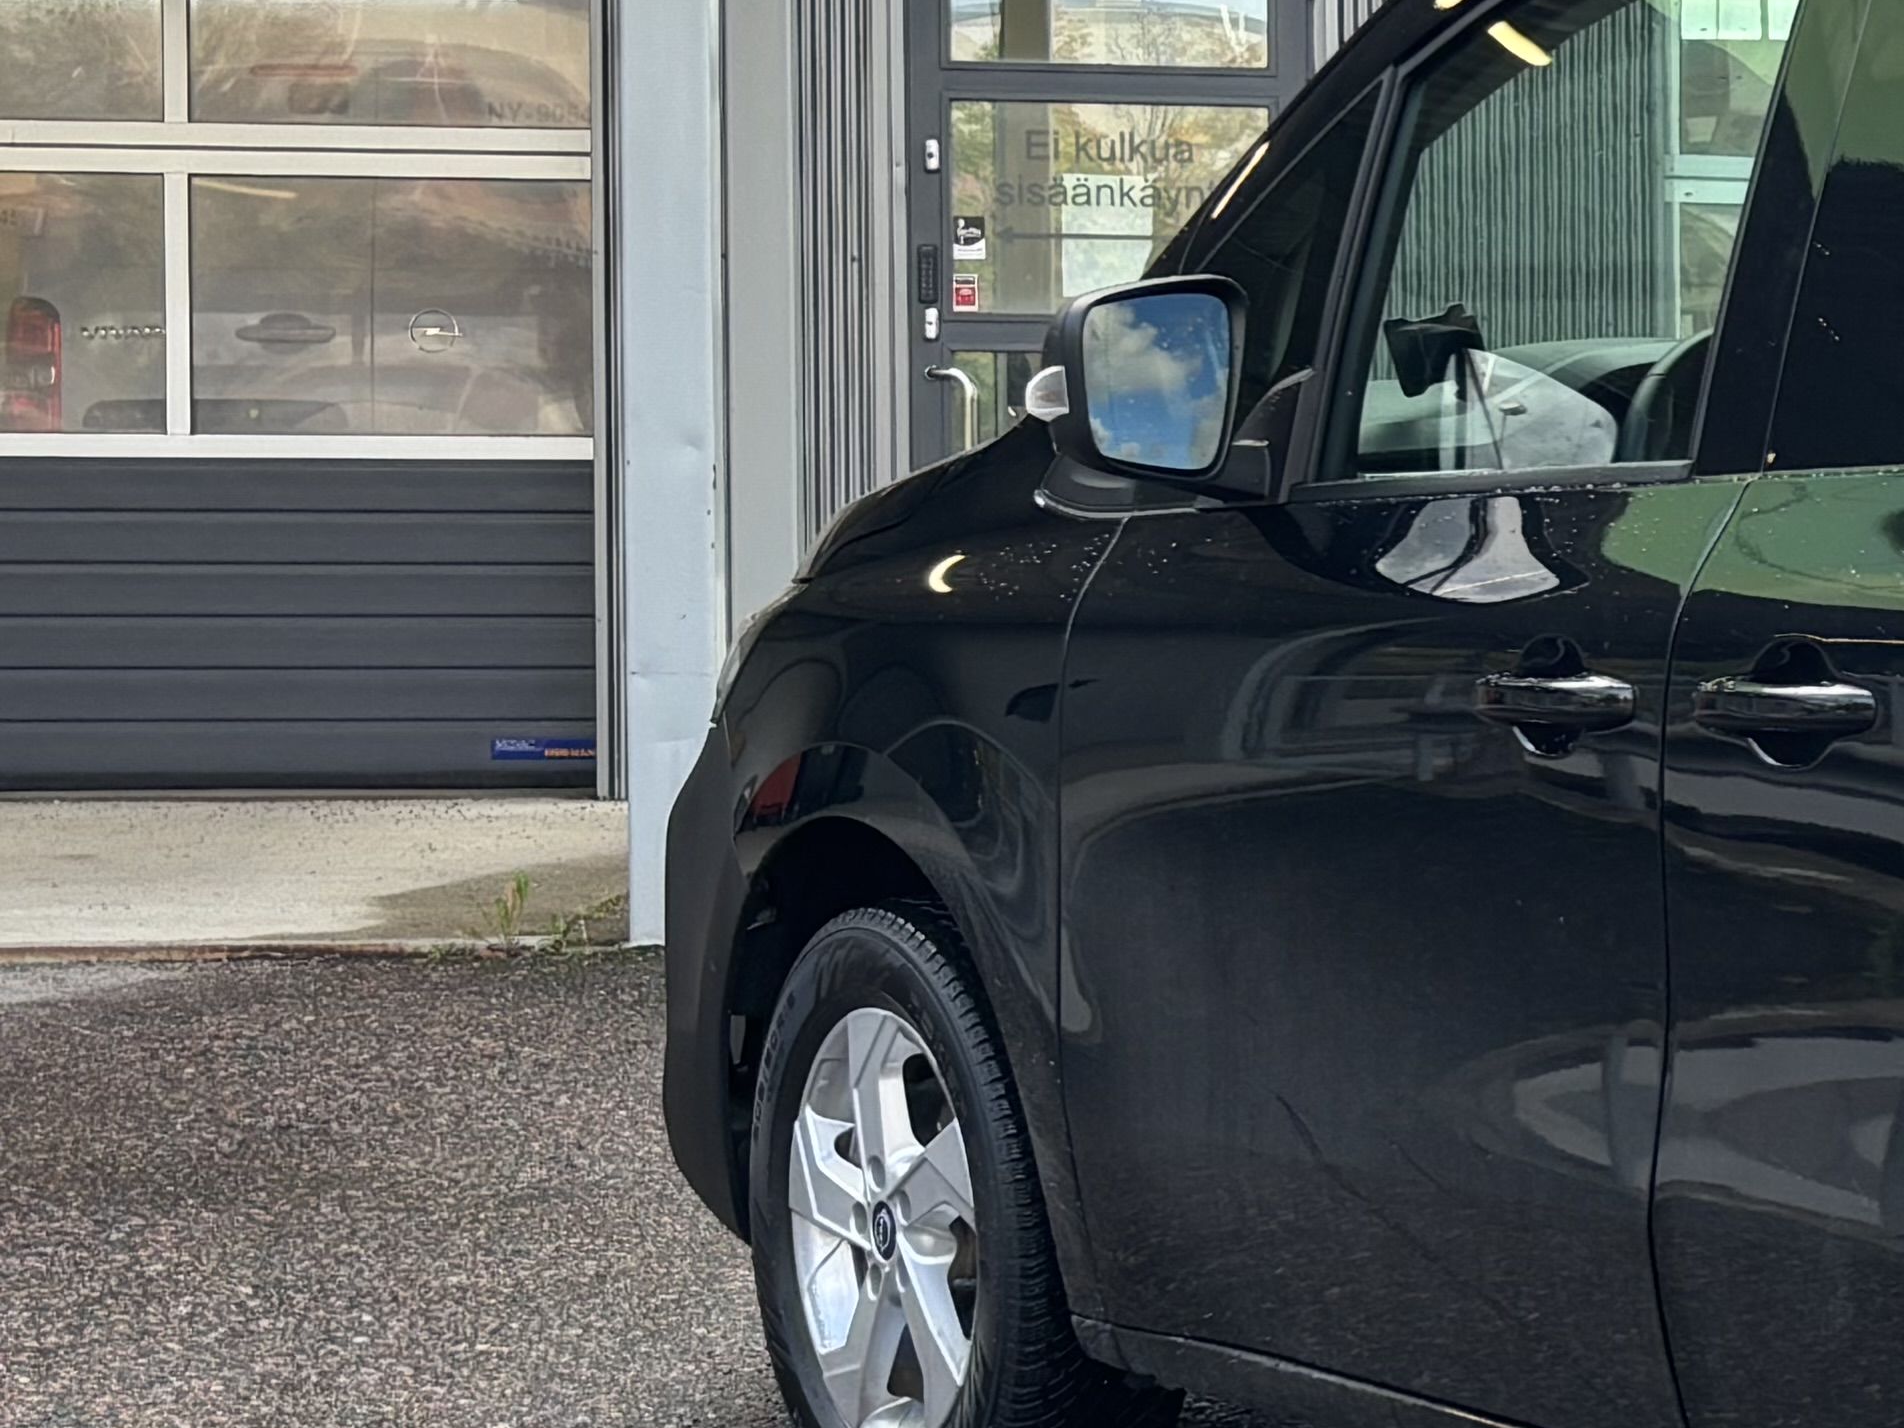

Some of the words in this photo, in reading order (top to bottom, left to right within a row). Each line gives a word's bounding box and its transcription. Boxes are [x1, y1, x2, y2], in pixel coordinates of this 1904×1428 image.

[1024, 129, 1060, 162] Ei
[1073, 129, 1194, 165] kulkua
[994, 175, 1215, 215] sisäänkäyn
